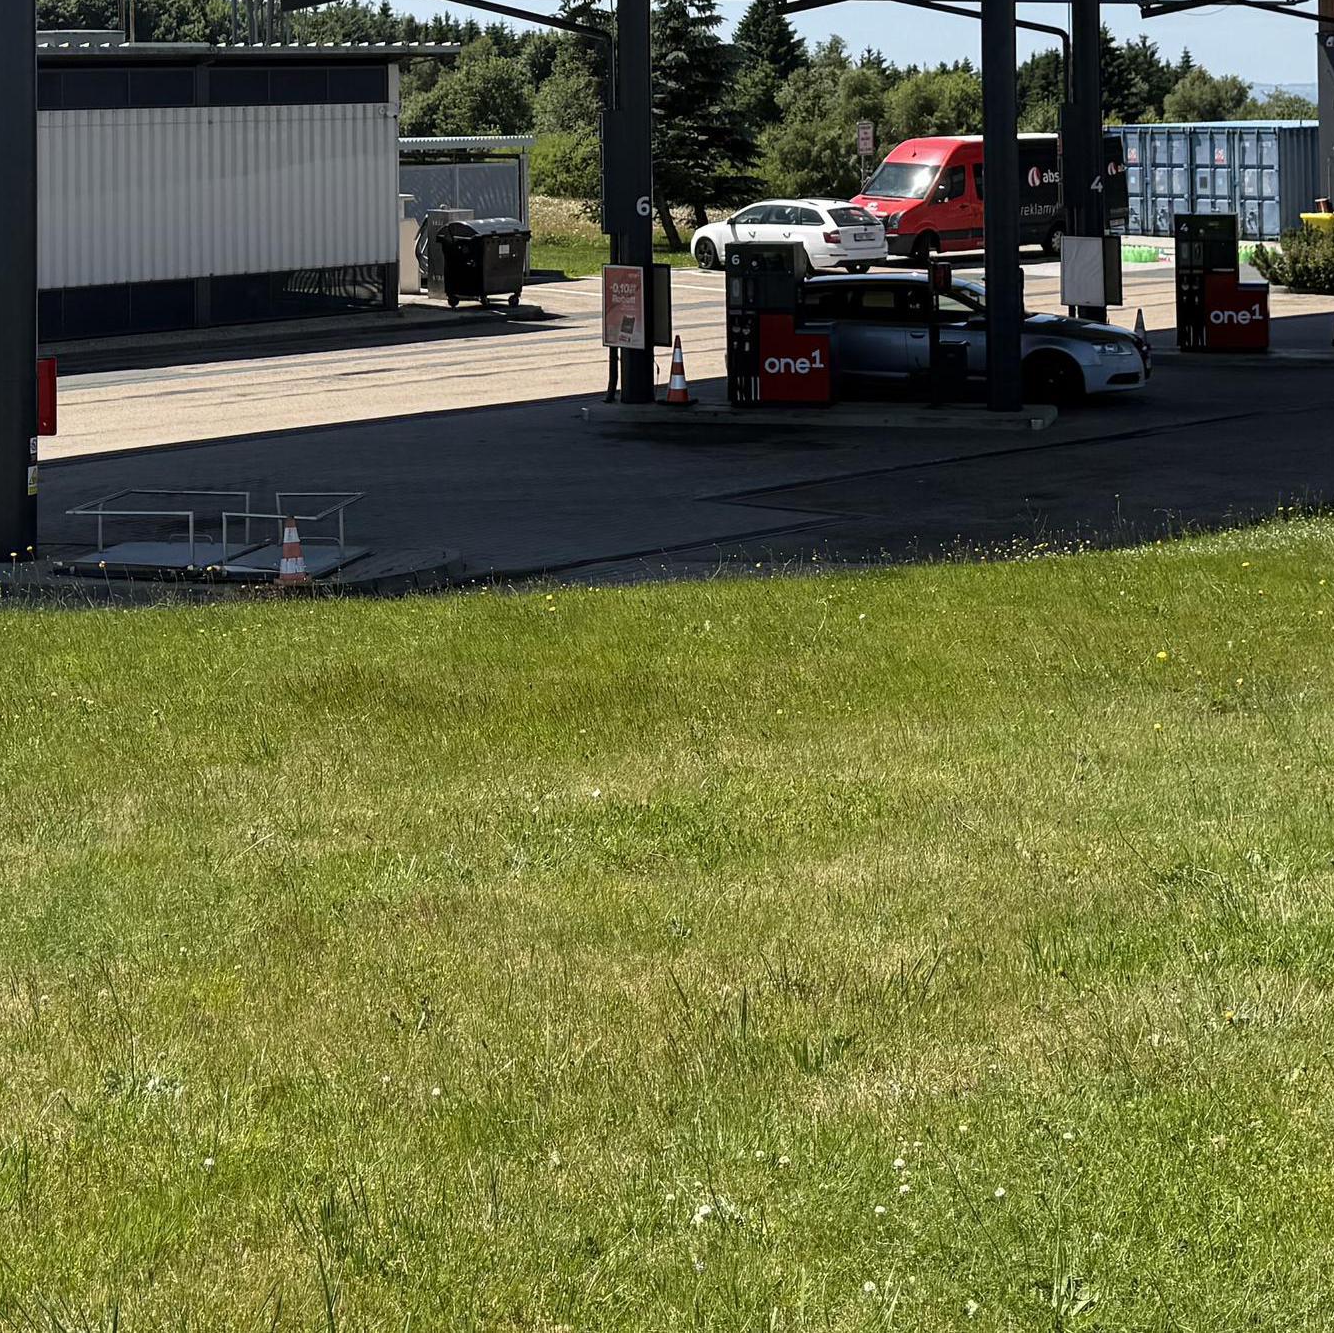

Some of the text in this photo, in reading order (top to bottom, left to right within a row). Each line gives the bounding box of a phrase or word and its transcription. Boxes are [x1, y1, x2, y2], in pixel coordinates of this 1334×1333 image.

[1090, 174, 1104, 193] 4
[636, 196, 650, 216] 6
[1180, 223, 1189, 232] 4
[731, 254, 740, 265] 6
